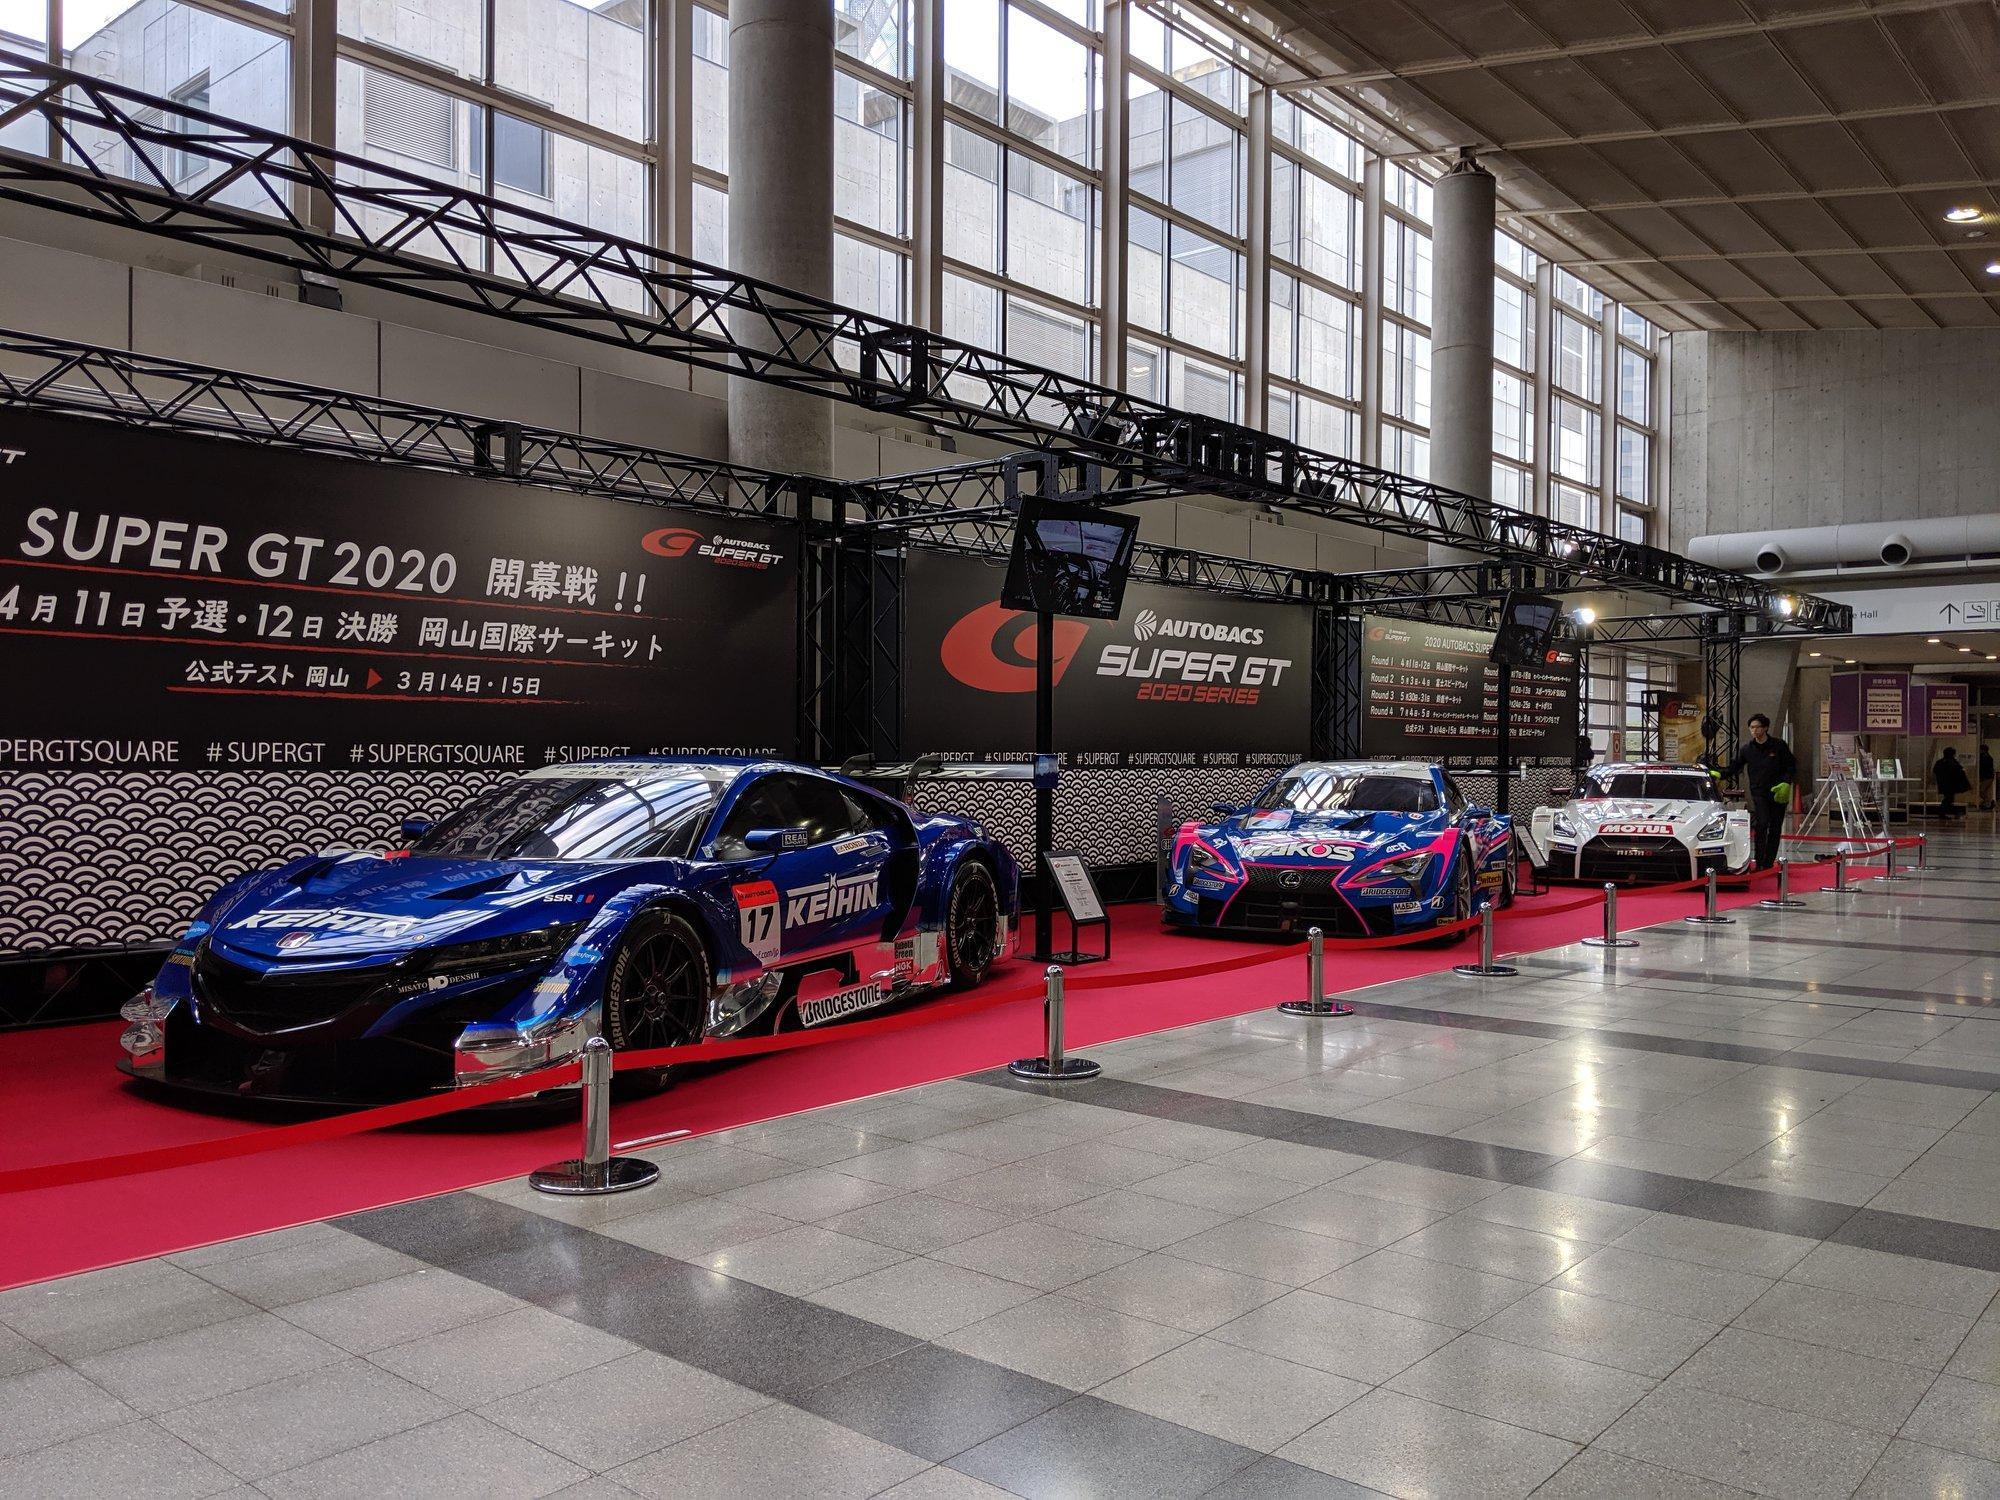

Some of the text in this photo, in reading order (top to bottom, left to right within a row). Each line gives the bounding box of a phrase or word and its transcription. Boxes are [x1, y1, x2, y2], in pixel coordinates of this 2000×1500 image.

[723, 538, 771, 551] AUTOBACS
[20, 507, 647, 613] SUPER GT 2020 開幕戦 !!
[698, 545, 784, 565] SUPER GT
[1860, 610, 1878, 619] Hall
[1157, 618, 1265, 646] AUTOBACS
[1424, 636, 1441, 647] 2020
[1441, 639, 1474, 652] AUTOBACS
[1096, 644, 1293, 687] SUPER GT
[1371, 655, 1389, 665] Round
[1390, 657, 1394, 666] 1
[185, 660, 294, 685] 公式テスト
[306, 666, 350, 688] 岡山
[1483, 666, 1499, 676] Round
[1370, 673, 1388, 683] Round
[1389, 674, 1395, 684] 2
[1483, 682, 1499, 692] Round
[1371, 689, 1389, 700] Round
[1389, 691, 1395, 700] 3
[1483, 698, 1499, 707] Round
[1370, 705, 1388, 715] Round
[1388, 706, 1394, 715] 4
[1483, 712, 1499, 721] Round
[1601, 824, 1671, 834] MOTUL
[784, 833, 807, 842] REAL
[1361, 887, 1412, 896] BRIDGESTONE
[543, 894, 573, 902] SSR
[785, 880, 879, 930] KEIHIN
[747, 905, 774, 944] 17
[895, 960, 912, 970] NGK
[397, 981, 428, 994] MISATO
[449, 971, 480, 984] DENSHI
[803, 982, 881, 1025] BRIDGESTONE
